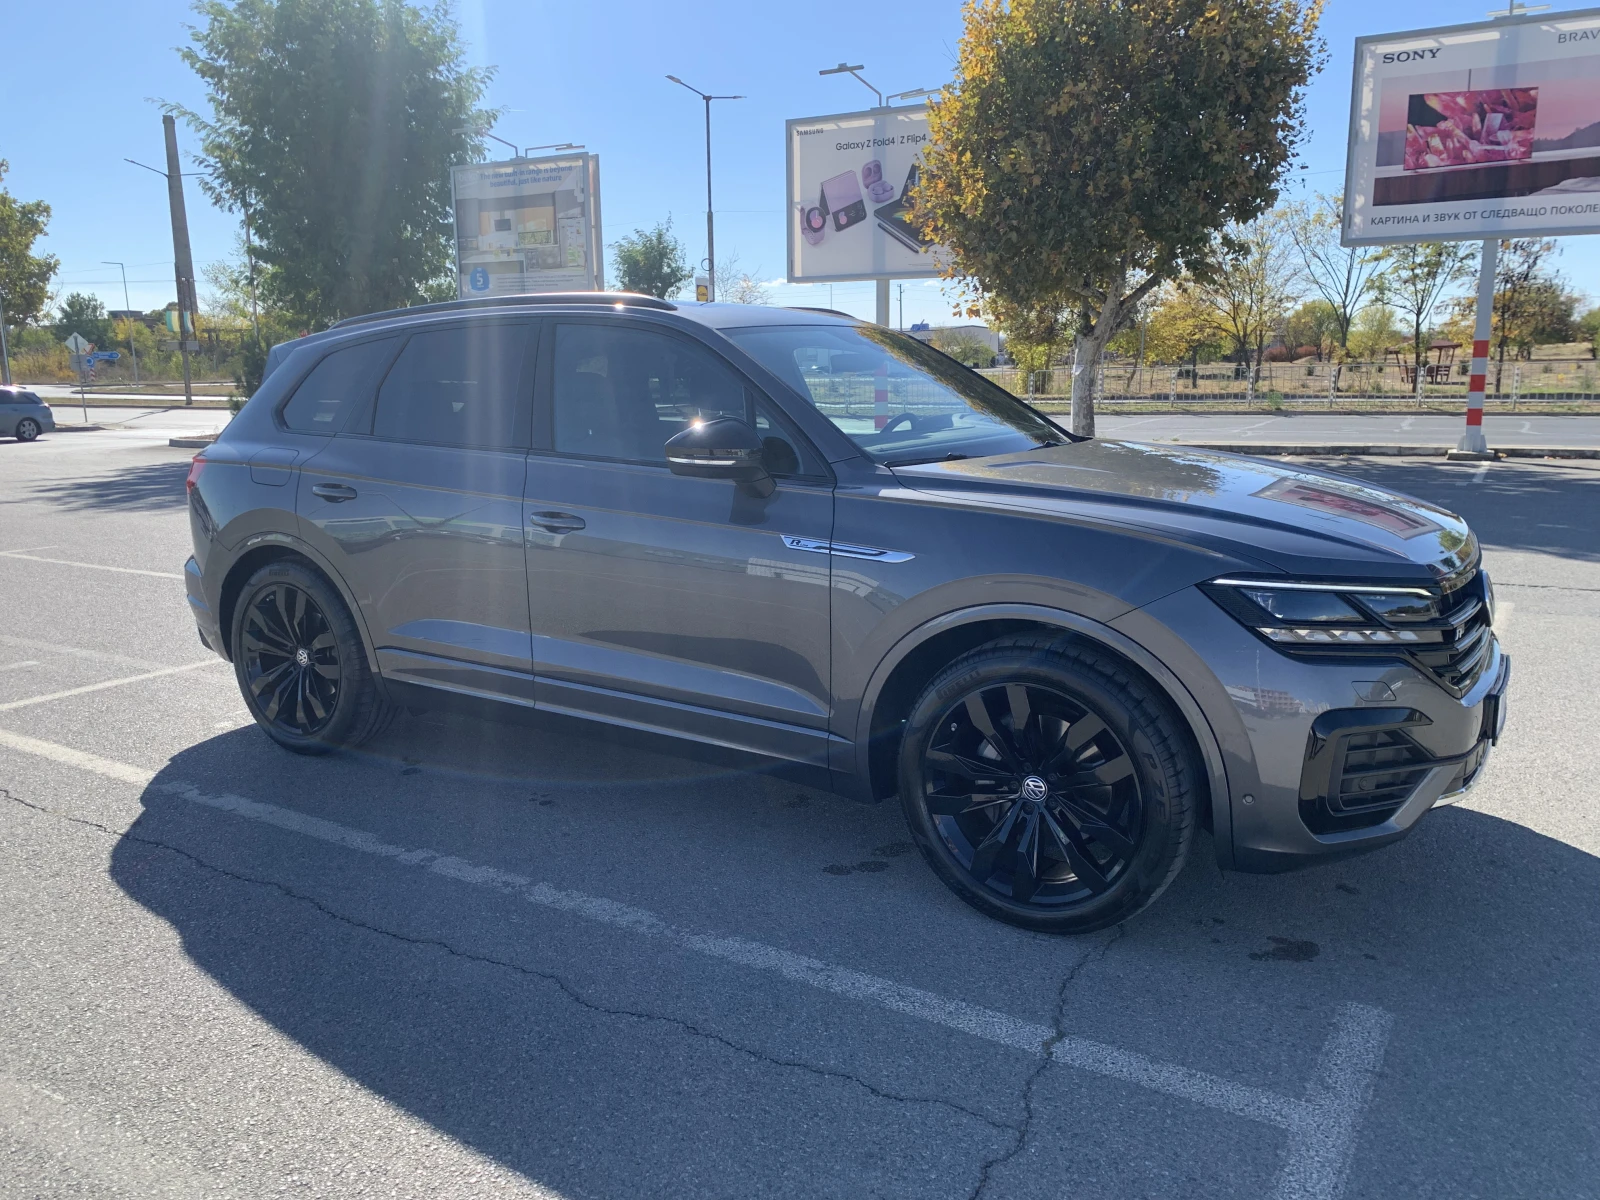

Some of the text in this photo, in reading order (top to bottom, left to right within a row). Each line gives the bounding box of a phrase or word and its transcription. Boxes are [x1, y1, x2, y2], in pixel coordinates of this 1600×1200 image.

[1557, 30, 1600, 44] BRAV
[1382, 47, 1443, 64] SONY
[796, 128, 824, 137] SAMSUNG
[836, 133, 927, 151] Galaxy Z Fold4 Z Flip4
[525, 168, 542, 177] range
[549, 165, 573, 174] beyond
[489, 175, 562, 188] beautiful, just like nature
[1370, 203, 1600, 226] КАРТИНА И ЗВУК ОТ СЛЕДВАЩО ПОКОЛЕ
[476, 272, 484, 285] 5
